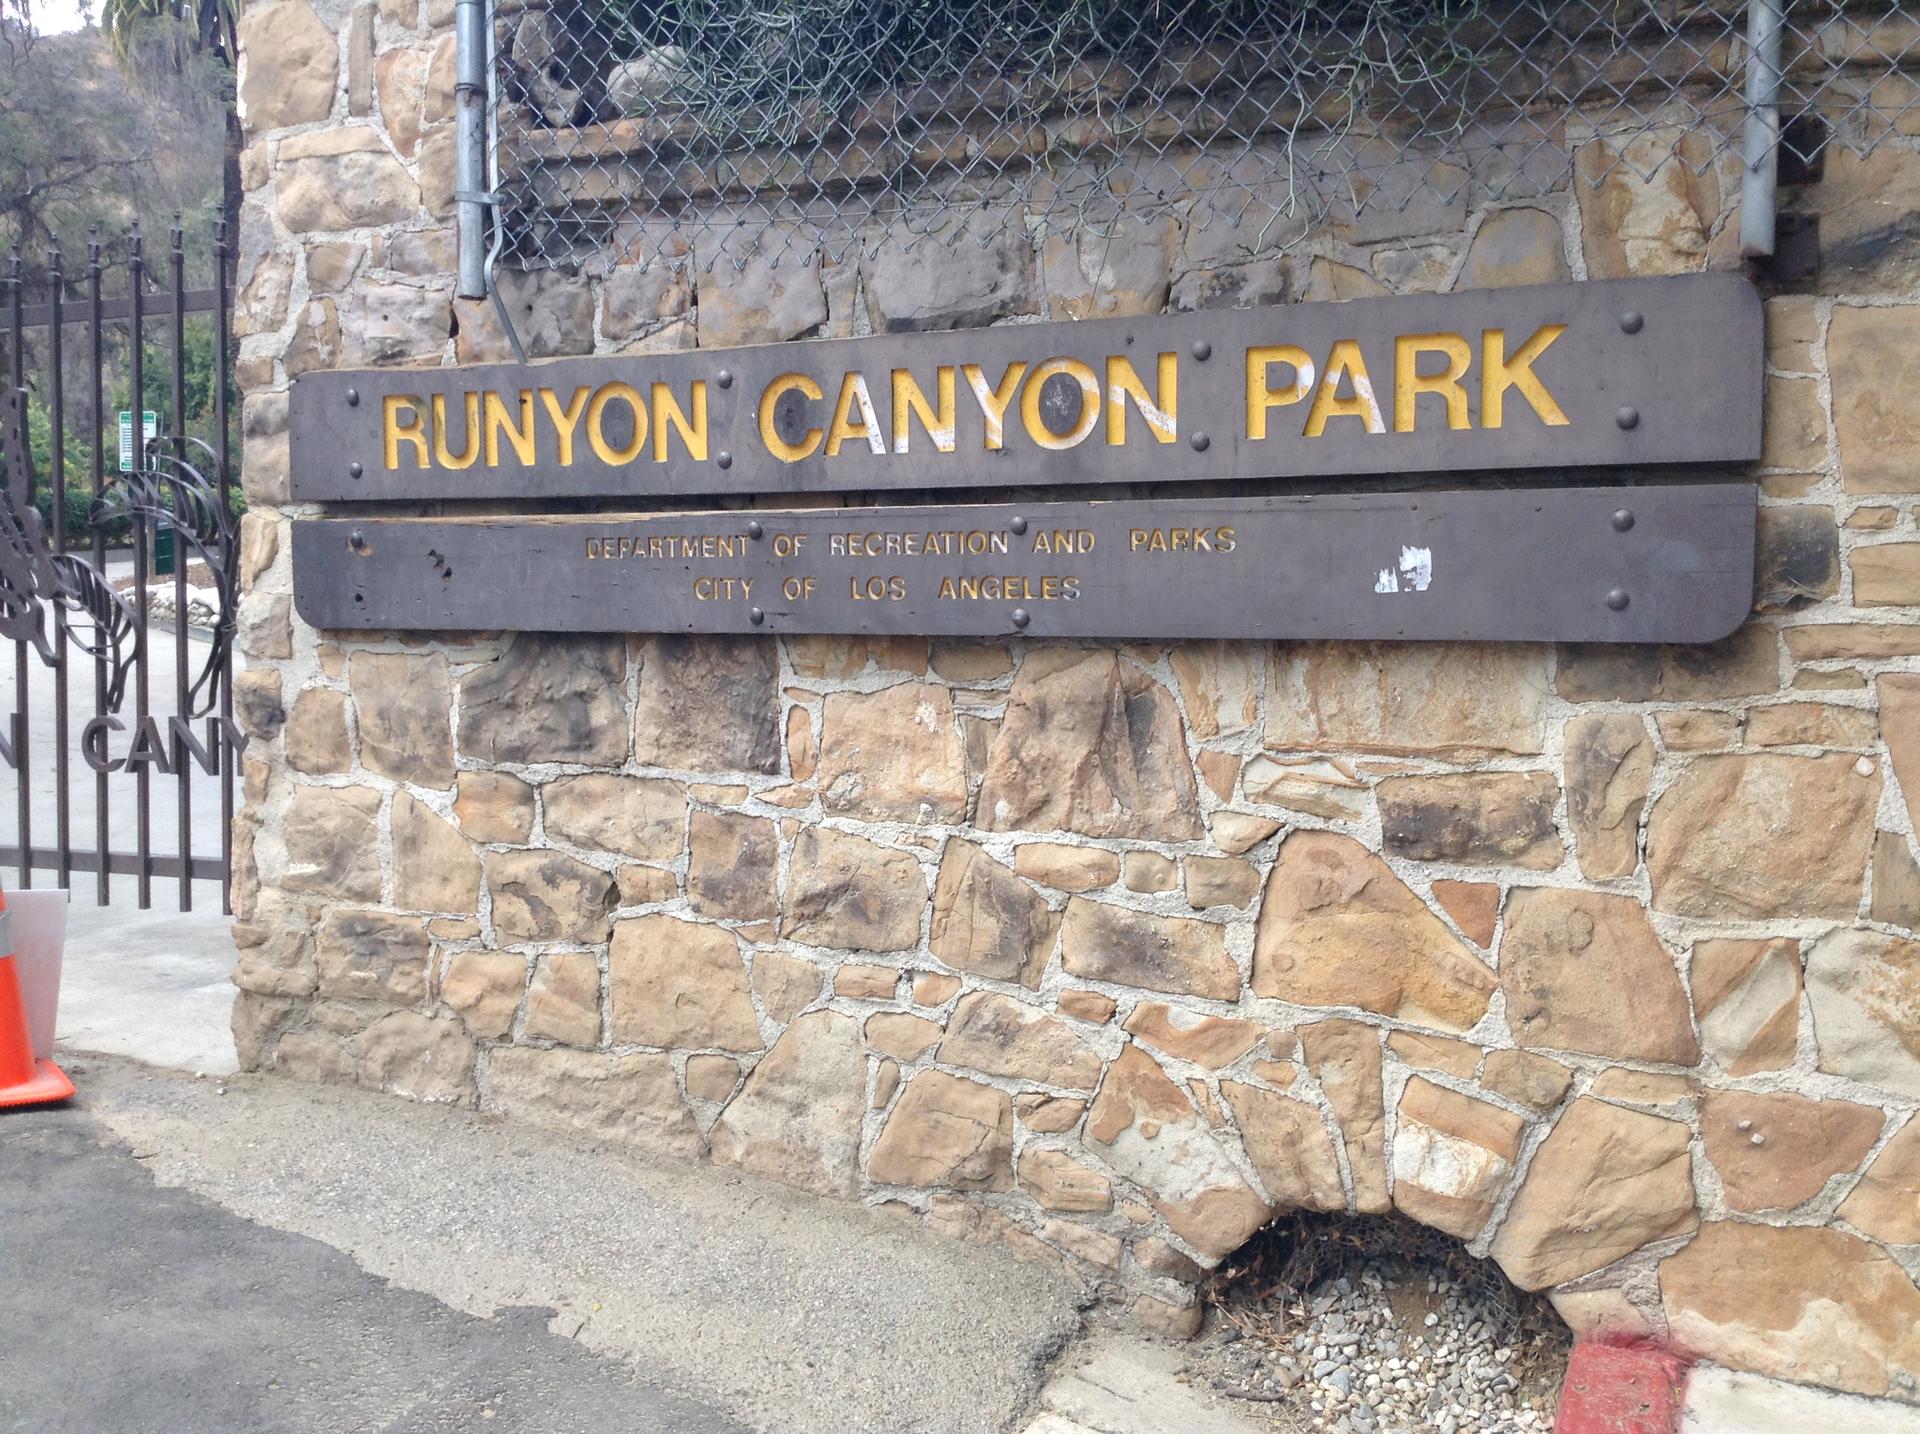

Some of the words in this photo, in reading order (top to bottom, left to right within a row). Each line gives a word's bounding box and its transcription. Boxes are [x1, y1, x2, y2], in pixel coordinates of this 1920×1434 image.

[383, 380, 708, 470] RUNYON
[757, 351, 1178, 463] CANYON
[1245, 323, 1571, 440] PARK
[585, 534, 749, 559] DEPARTMENT
[772, 533, 808, 557] OF
[829, 529, 1009, 556] RECREATION
[1032, 528, 1096, 554] AND
[1129, 526, 1237, 552] PARKS
[693, 575, 754, 601] CITY
[782, 575, 817, 601] OF
[849, 575, 906, 601] LOS
[937, 575, 1081, 601] ANGELES
